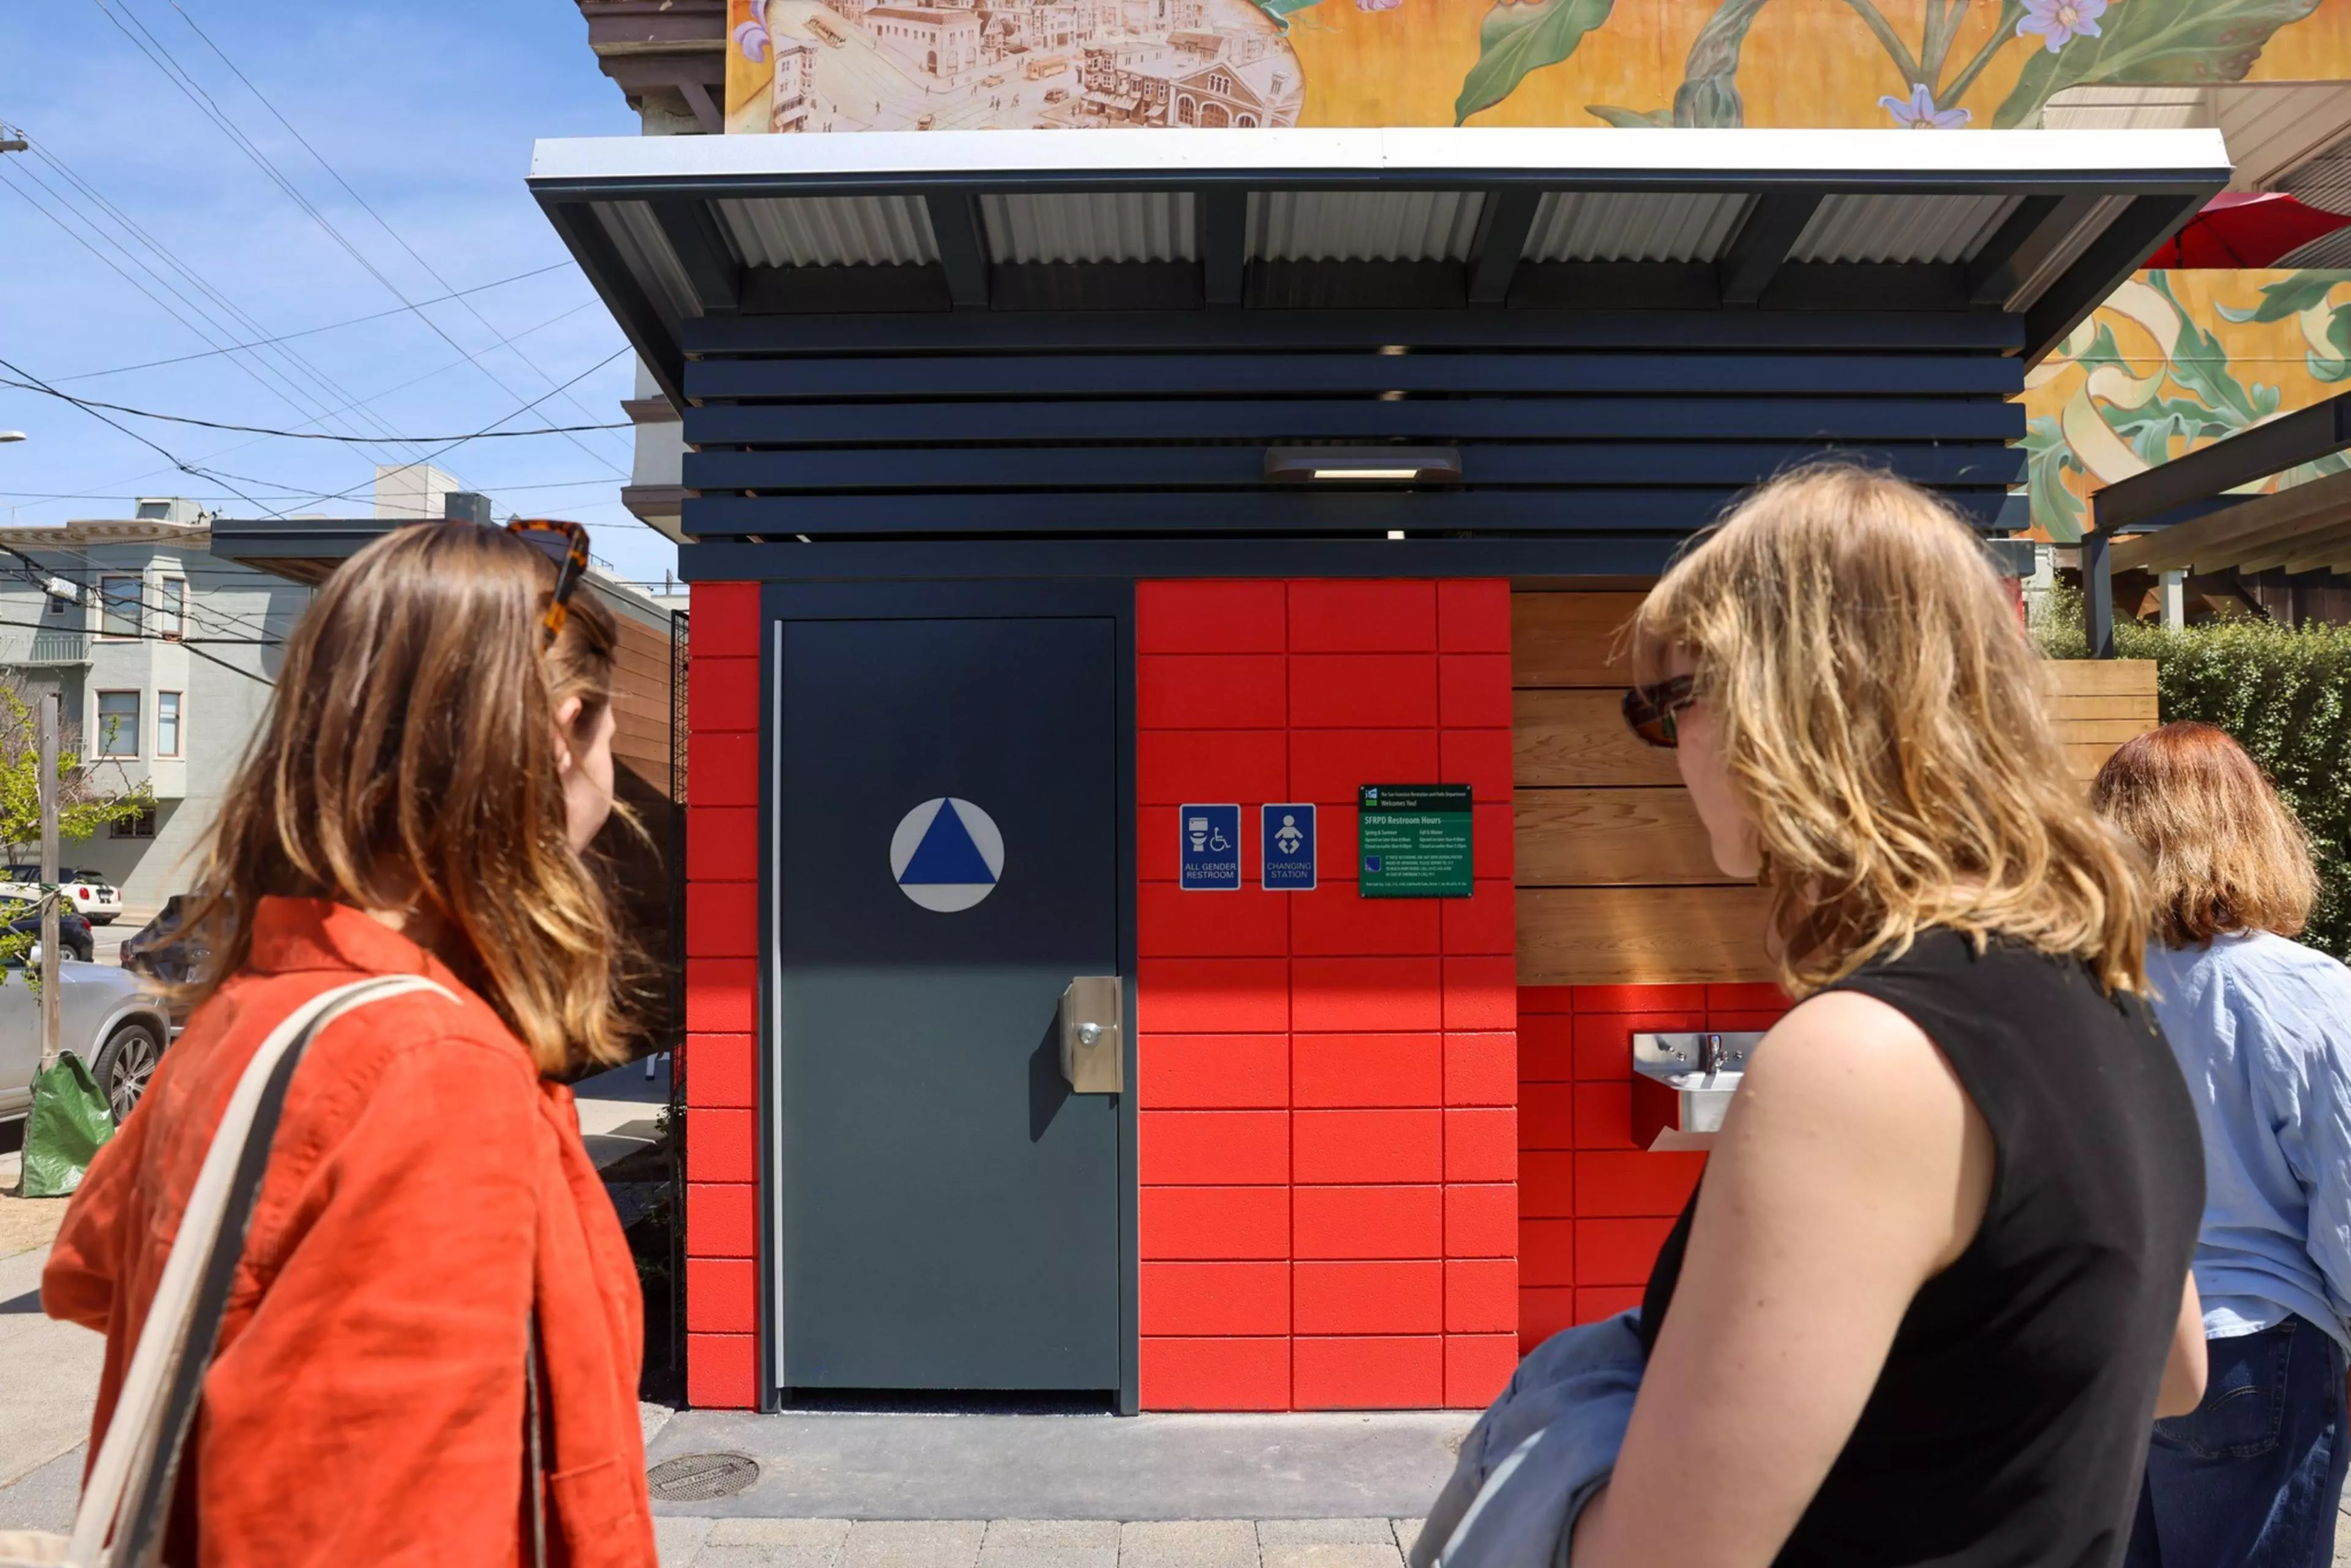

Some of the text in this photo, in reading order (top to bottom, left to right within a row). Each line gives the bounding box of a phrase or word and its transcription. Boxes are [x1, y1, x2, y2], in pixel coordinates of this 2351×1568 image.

[1364, 816, 1442, 825] SFRPD Restroom Hours
[1202, 862, 1237, 871] GENDER
[1187, 871, 1234, 879] RESTROOM
